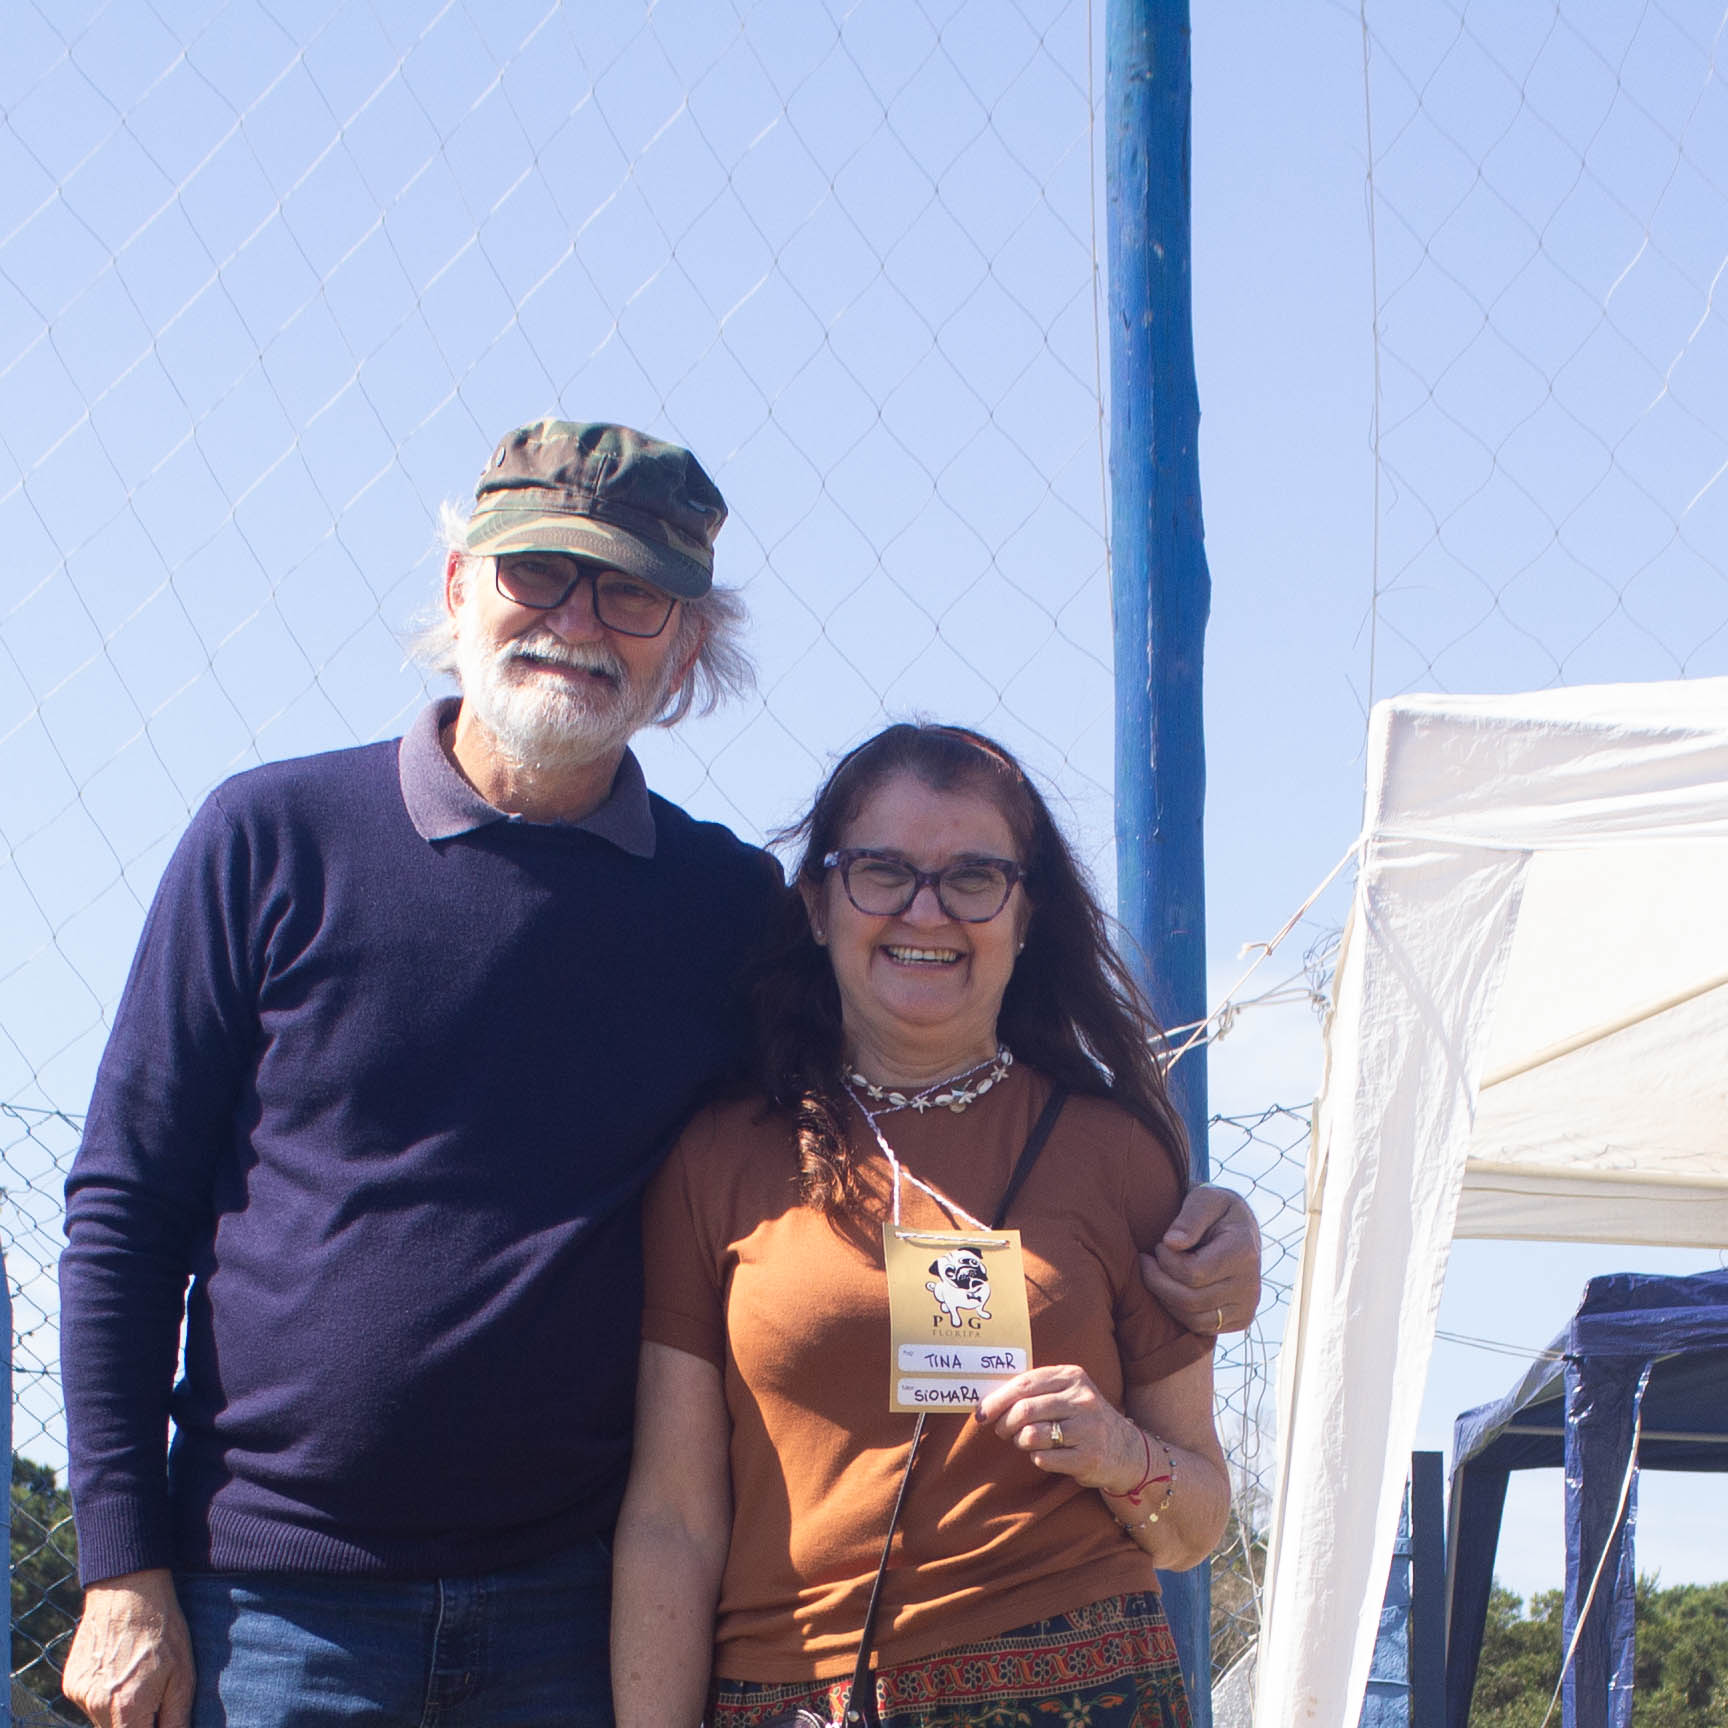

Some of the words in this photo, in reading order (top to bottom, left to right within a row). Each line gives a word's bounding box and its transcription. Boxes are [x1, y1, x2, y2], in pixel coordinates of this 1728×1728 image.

[932, 1314, 982, 1330] PUG
[932, 1330, 982, 1338] FLORIPA
[924, 1353, 962, 1369] TINA
[980, 1352, 1016, 1369] STAR
